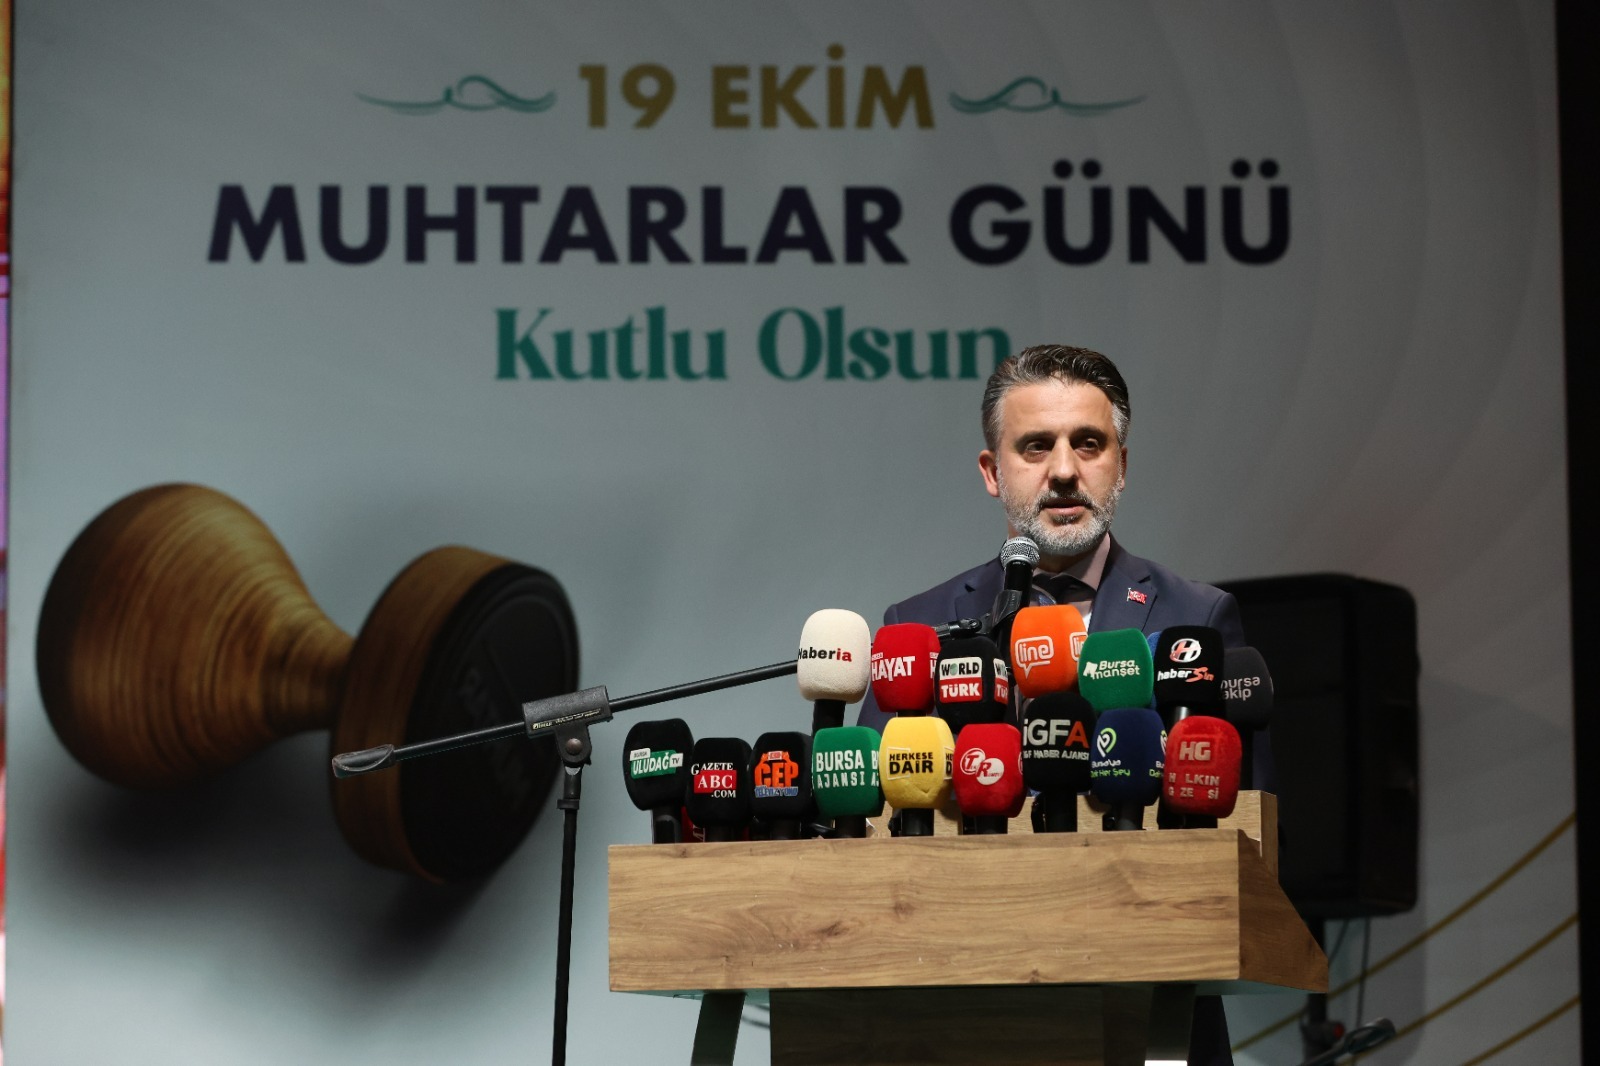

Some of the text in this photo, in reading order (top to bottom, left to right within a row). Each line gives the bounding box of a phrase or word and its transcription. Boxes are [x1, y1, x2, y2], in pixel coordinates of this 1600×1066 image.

[579, 43, 936, 130] 19 EKİM
[207, 158, 1292, 266] MUHTARLAR GÜNÜ
[494, 305, 1012, 382] Kutlu Olsun
[798, 646, 852, 662] Haberia
[1019, 643, 1049, 662] line
[872, 656, 916, 682] HAYAT
[941, 662, 979, 676] WORLD
[1090, 664, 1140, 680] manşet
[1099, 659, 1135, 671] Bursa
[941, 682, 980, 698] TÜRK
[889, 752, 934, 762] HERKESE
[1033, 749, 1060, 759] HABER
[1179, 741, 1211, 761] HG
[632, 751, 680, 776] ULUDAĞ TV
[690, 762, 734, 776] GAZETE
[815, 749, 865, 773] BURSA
[698, 774, 733, 789] ABC
[754, 761, 799, 788] CEP
[817, 771, 866, 789] AJANSI
[711, 789, 736, 798] .COM
